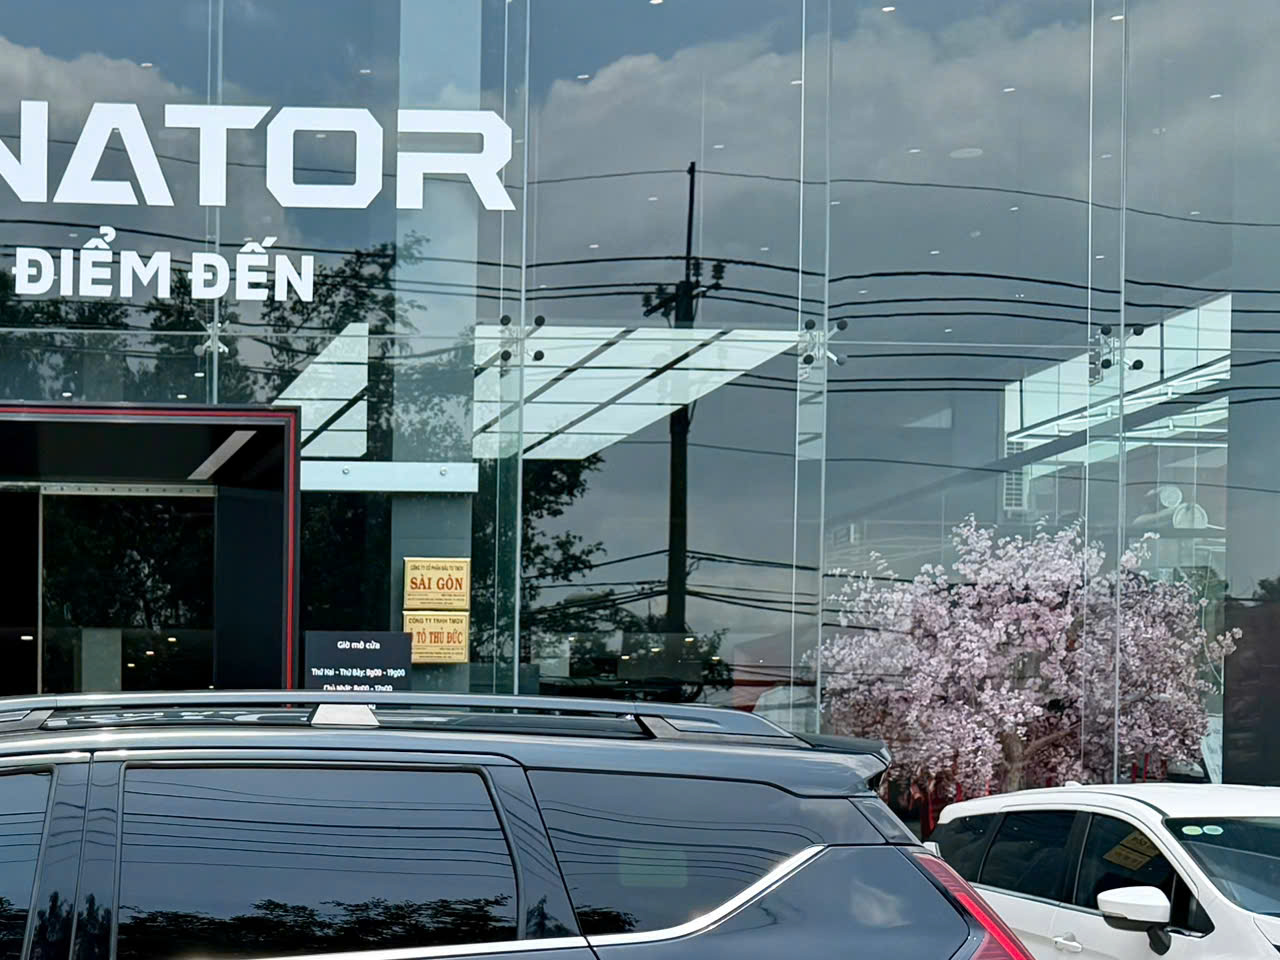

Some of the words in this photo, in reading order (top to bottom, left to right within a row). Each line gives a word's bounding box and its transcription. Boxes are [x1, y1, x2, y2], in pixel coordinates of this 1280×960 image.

[12, 226, 171, 299] ĐIỂM
[188, 236, 314, 302] ĐẾN
[410, 573, 432, 591] SÀI
[436, 573, 464, 591] GÒN
